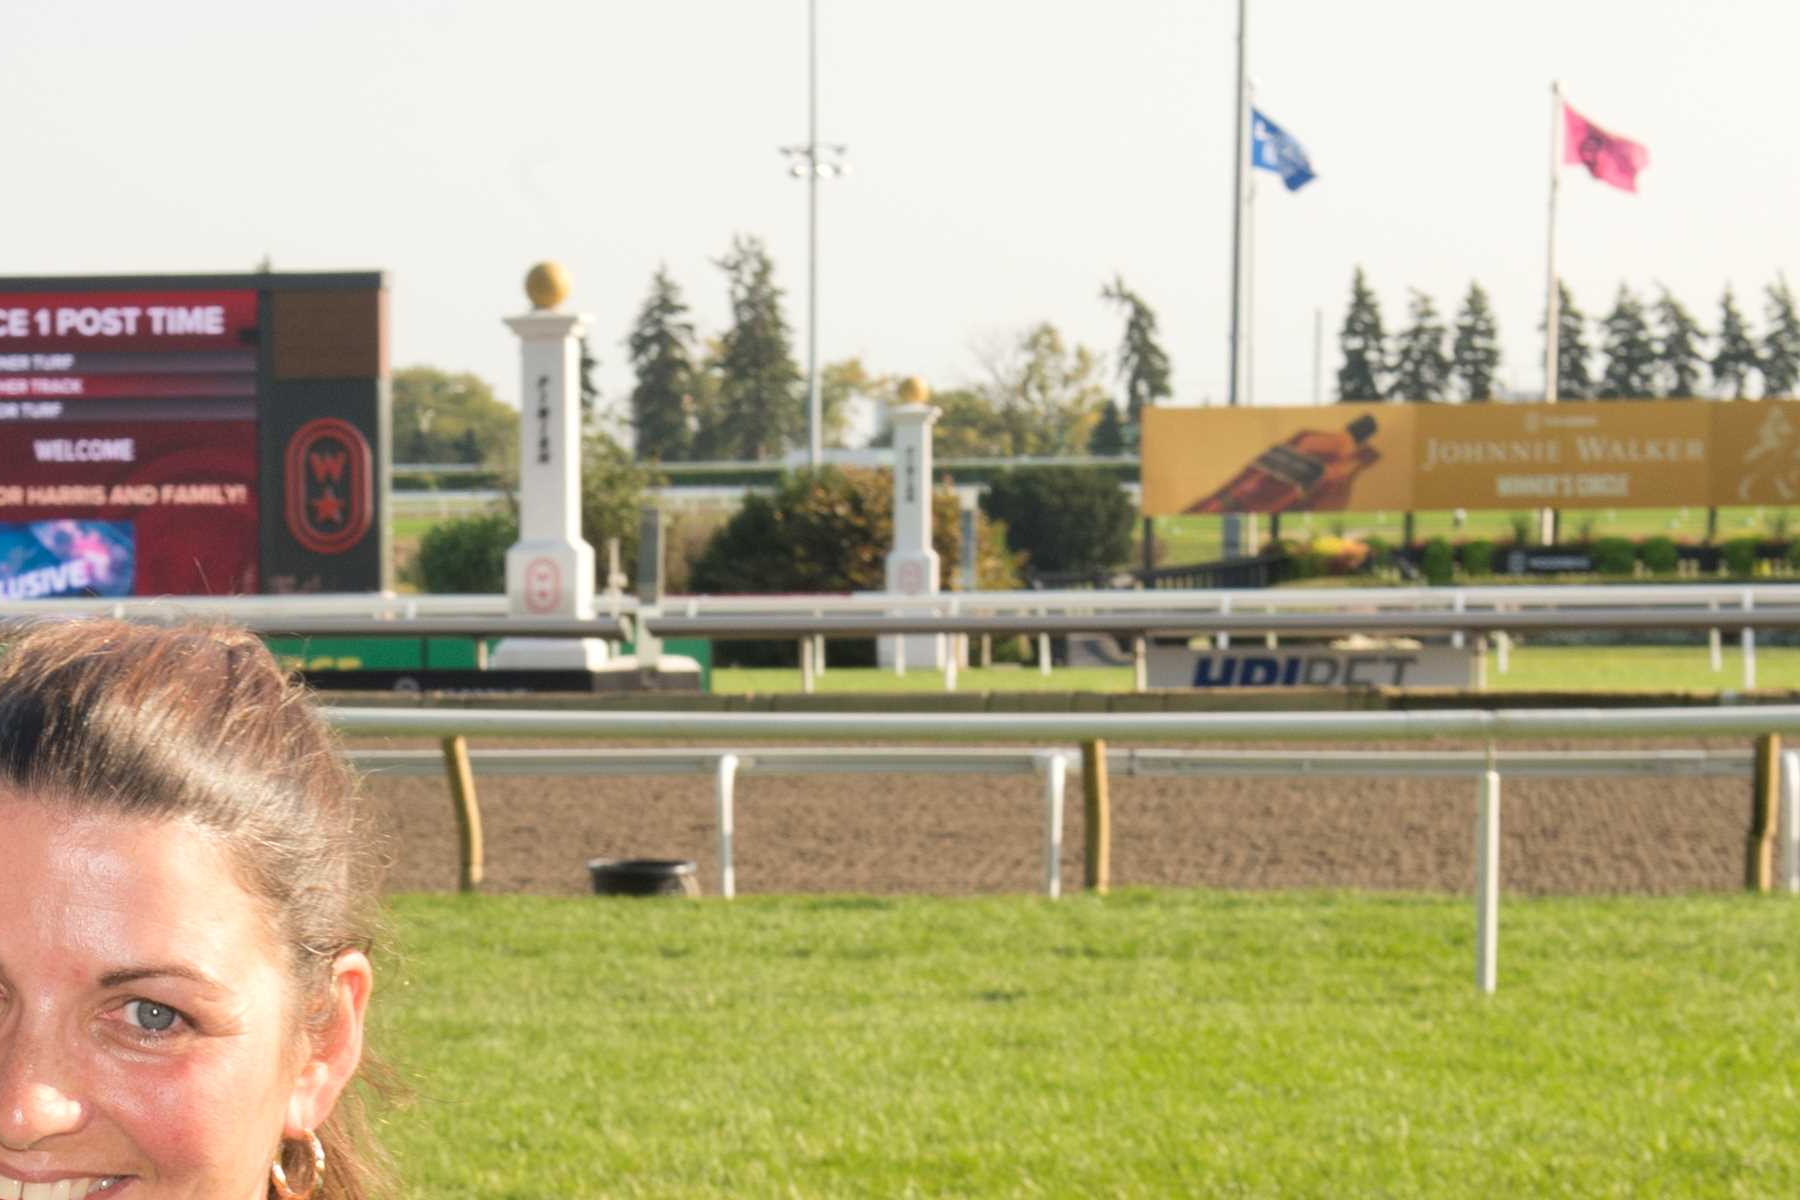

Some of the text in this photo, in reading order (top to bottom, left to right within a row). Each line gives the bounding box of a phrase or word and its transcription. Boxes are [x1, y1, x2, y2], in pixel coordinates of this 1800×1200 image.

[35, 309, 50, 335] 1
[56, 307, 140, 336] POST
[147, 306, 225, 334] TIME
[31, 378, 83, 395] TRACK
[34, 438, 134, 462] WELCOME
[1422, 436, 1704, 470] JOHNNIE WALKER
[27, 485, 105, 506] HARRIS
[109, 485, 158, 505] AND
